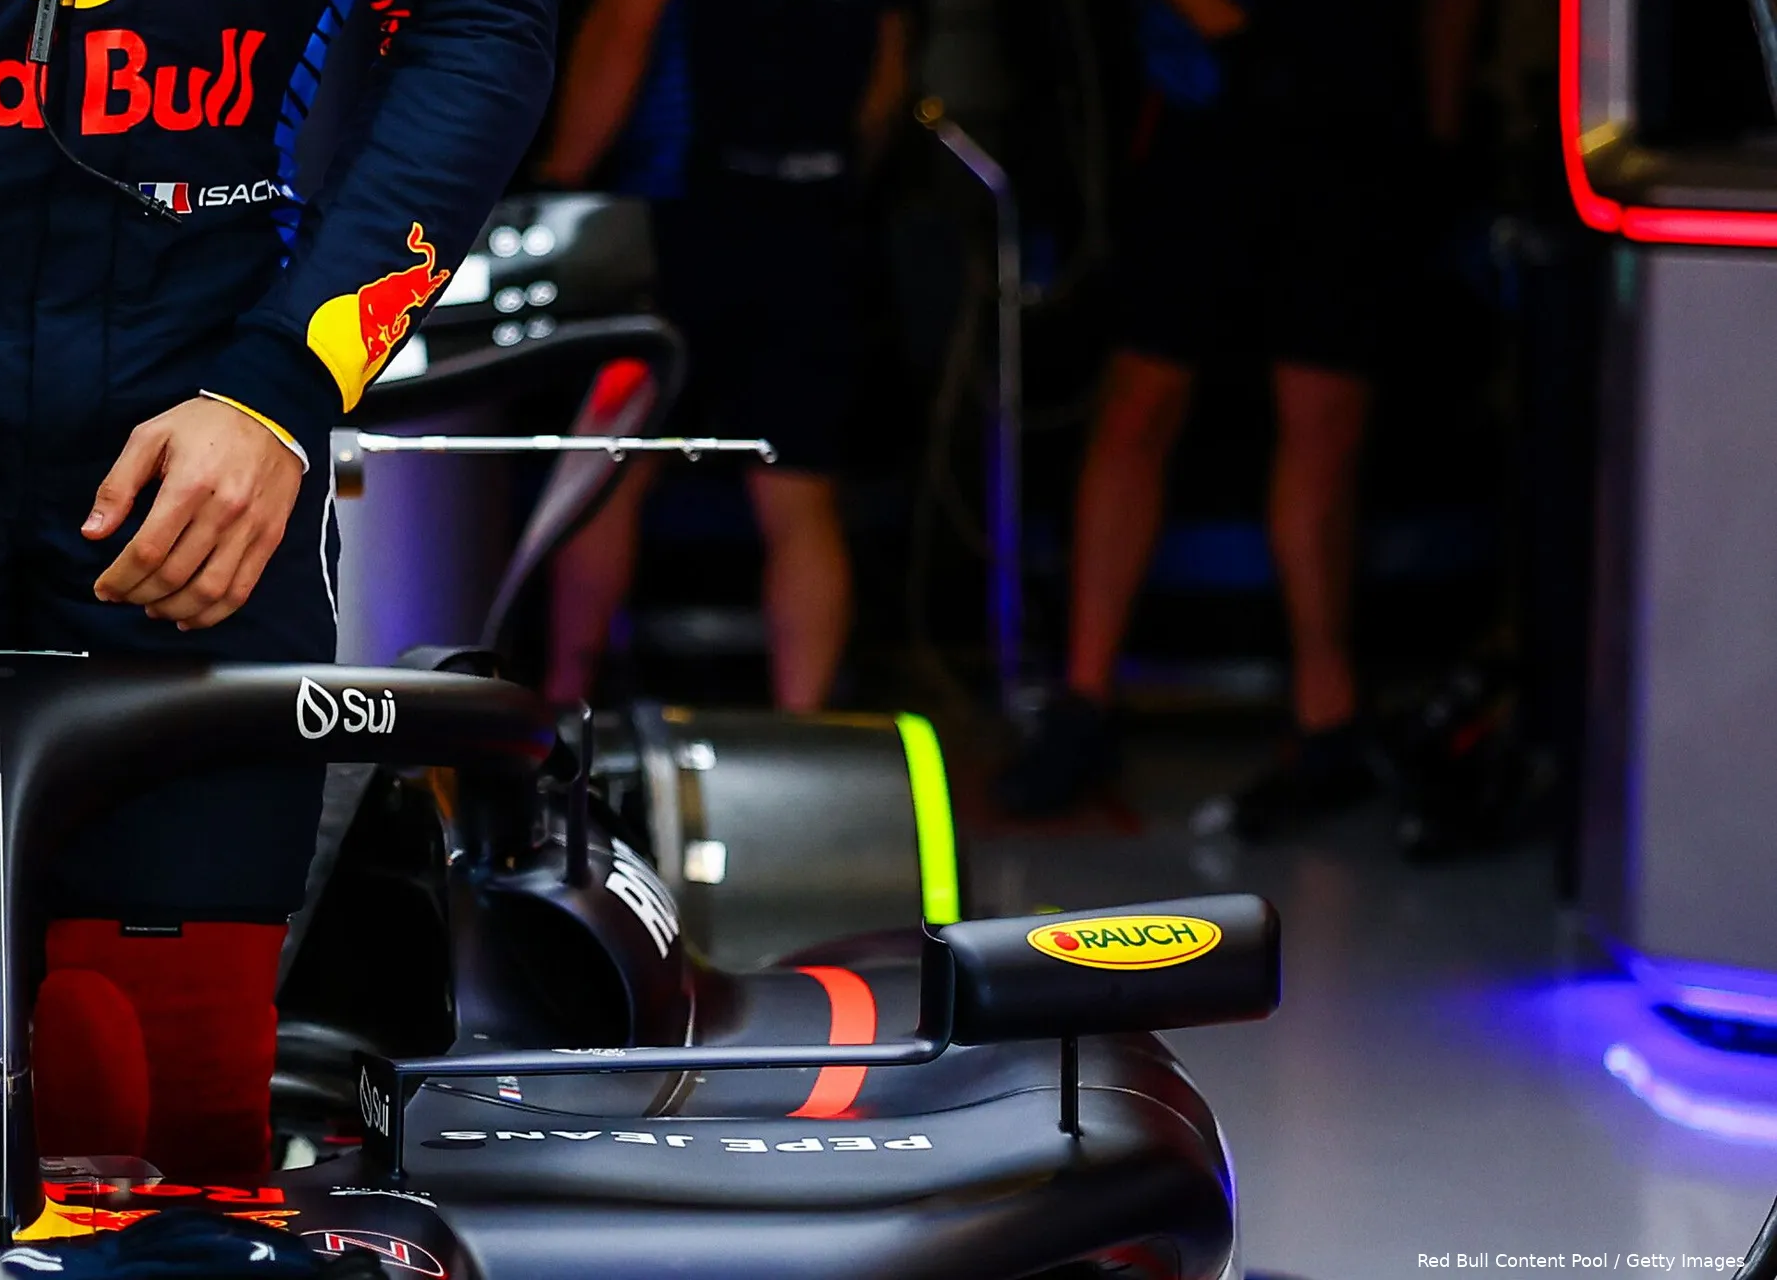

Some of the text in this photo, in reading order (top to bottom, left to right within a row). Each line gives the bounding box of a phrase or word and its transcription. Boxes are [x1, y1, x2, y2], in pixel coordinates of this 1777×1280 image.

[81, 27, 266, 135] Bull
[343, 689, 396, 734] Sui
[1076, 922, 1199, 950] RAUCH
[440, 1131, 933, 1152] PEPE JEANS
